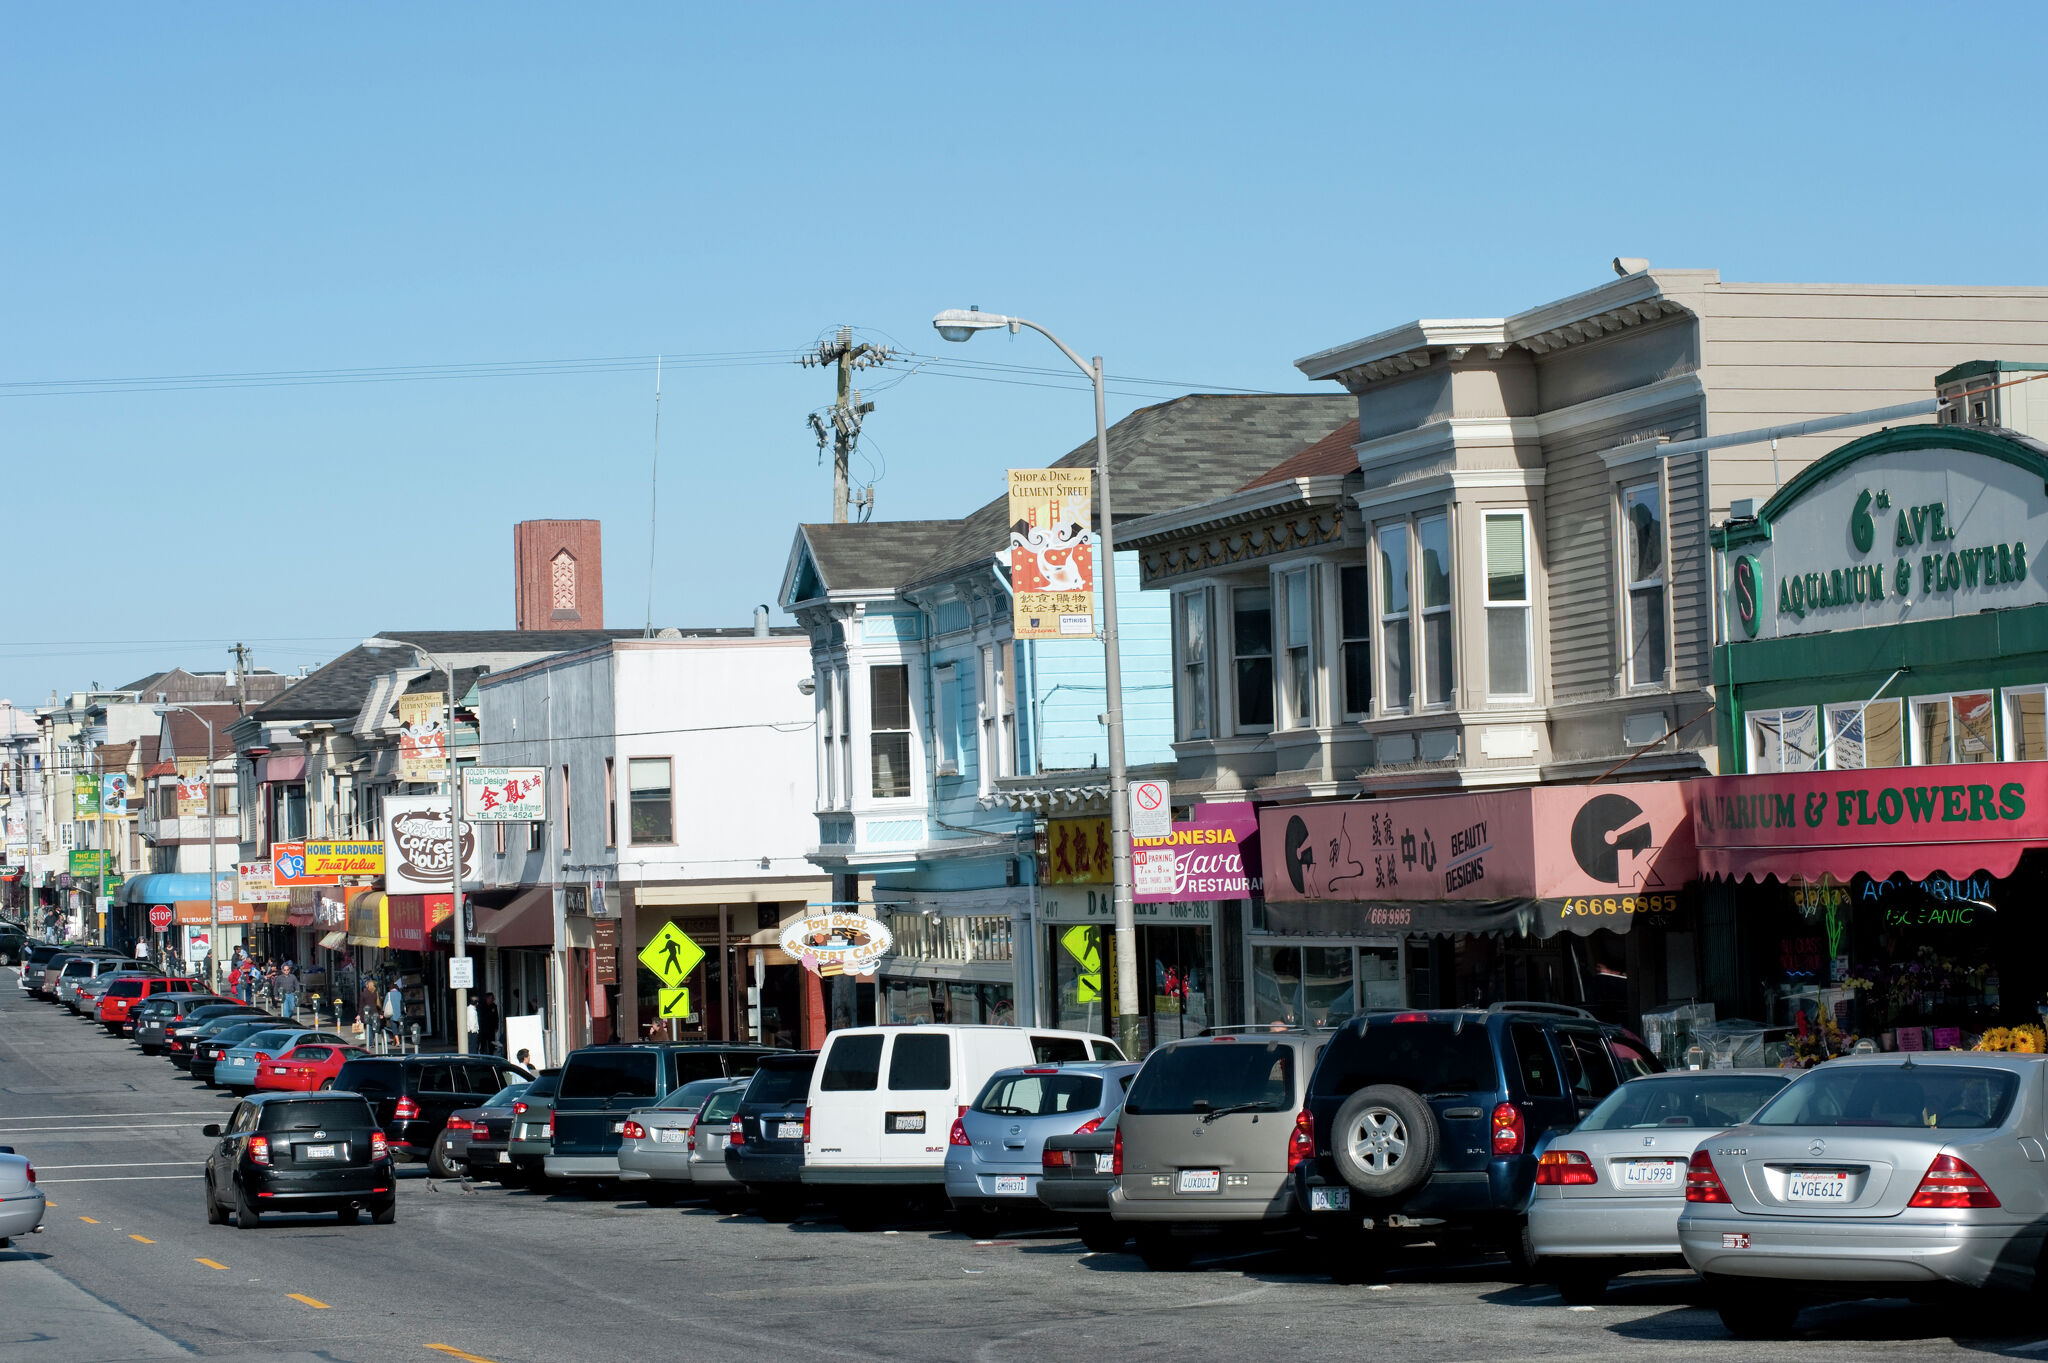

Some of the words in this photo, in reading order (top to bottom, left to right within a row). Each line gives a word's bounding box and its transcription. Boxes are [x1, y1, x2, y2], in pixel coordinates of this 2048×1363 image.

[1014, 472, 1038, 482] SHOP
[1040, 473, 1046, 481] &
[1050, 471, 1071, 481] DINE
[1013, 484, 1054, 497] CLEMENT
[1056, 483, 1088, 497] STREET
[1896, 502, 1955, 547] AVE.
[1779, 562, 1885, 619] AQUARIUM
[1896, 558, 1911, 596] &
[1921, 541, 2028, 594] FLOWERS
[468, 777, 483, 785] Hair
[484, 776, 507, 786] Design
[499, 803, 507, 811] For
[1804, 792, 1827, 828] &
[1836, 782, 2025, 826] FLOWERS
[400, 834, 453, 854] Coffee
[1133, 828, 1237, 847] INDONESIA
[1451, 821, 1488, 858] BEAUTY
[307, 844, 332, 855] HOME
[335, 844, 384, 855] HARDWARE
[1135, 853, 1147, 865] NO
[1148, 854, 1173, 863] PARKING
[1401, 827, 1437, 872] 中心
[1171, 848, 1244, 895] Java
[1445, 858, 1484, 893] DESIGNS
[1087, 890, 1096, 915] D
[1574, 896, 1677, 916] 668-8885
[152, 911, 171, 921] STOP
[804, 918, 828, 931] Toy
[832, 914, 868, 930] Boat
[786, 939, 846, 961] DESSERT
[853, 938, 888, 959] CAFE
[1183, 1177, 1217, 1188] 4UXD017
[1628, 1167, 1672, 1181] 4JTJ998
[1792, 1181, 1843, 1197] 4YGE612
